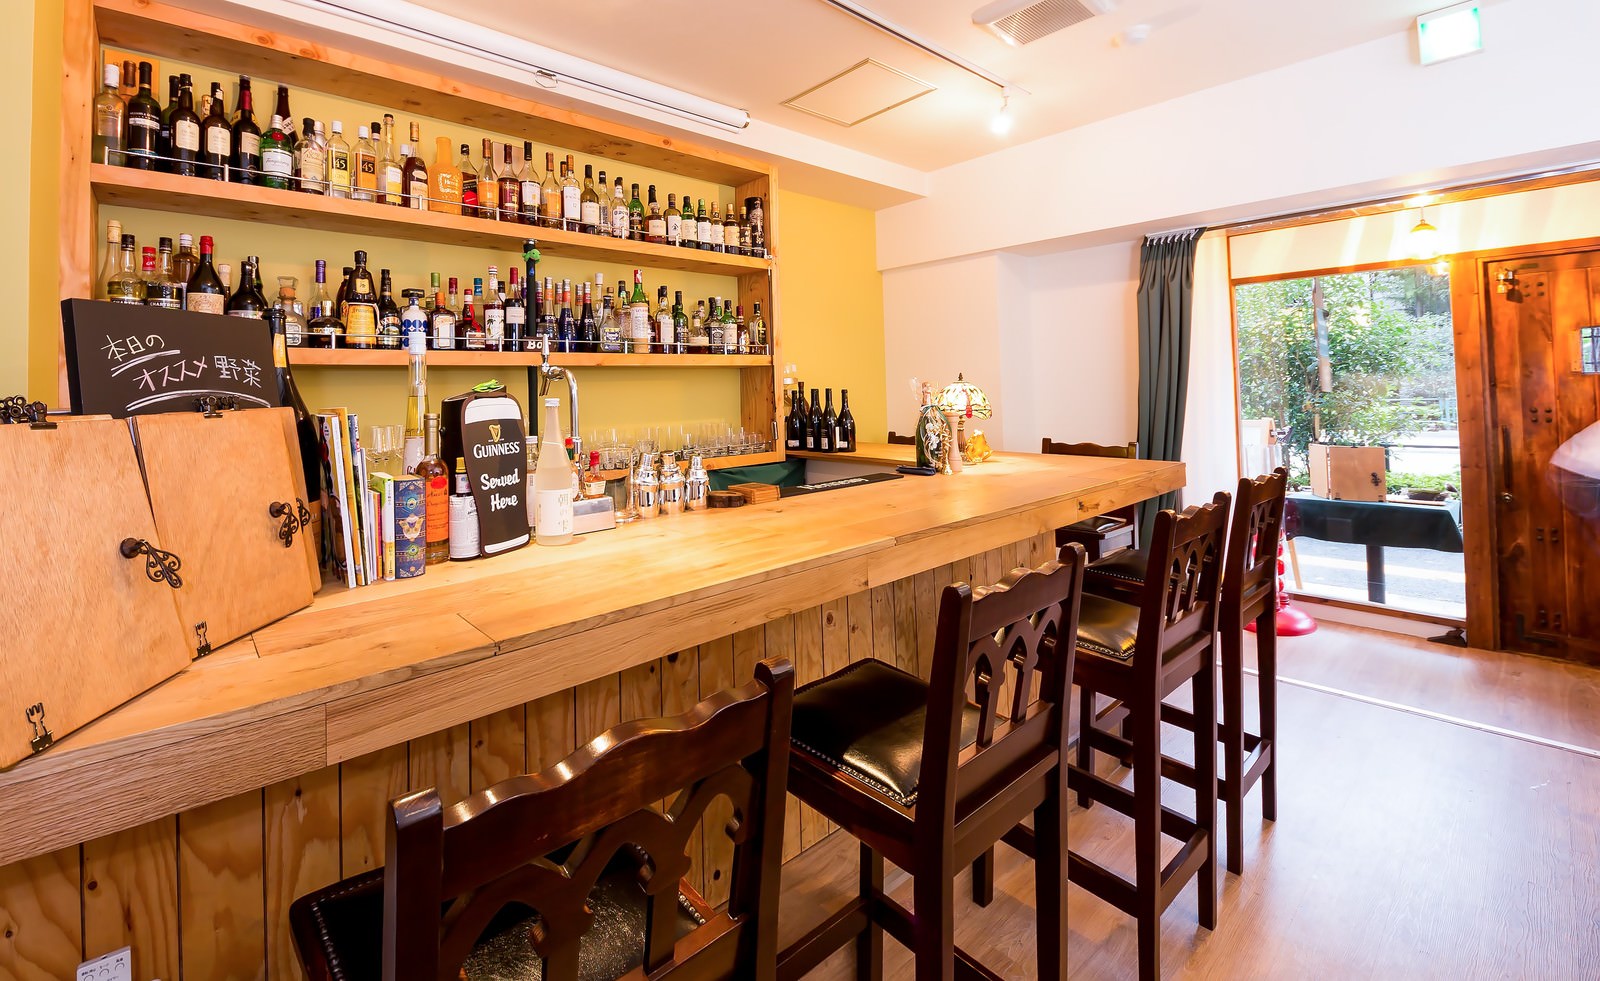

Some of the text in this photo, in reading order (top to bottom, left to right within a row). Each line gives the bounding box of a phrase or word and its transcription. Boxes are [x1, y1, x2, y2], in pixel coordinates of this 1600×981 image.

[335, 158, 346, 169] 45
[362, 161, 374, 173] 45
[101, 334, 165, 361] 本日の
[473, 441, 520, 459] GUINNESS
[480, 468, 521, 491] Served
[490, 493, 519, 512] Here
